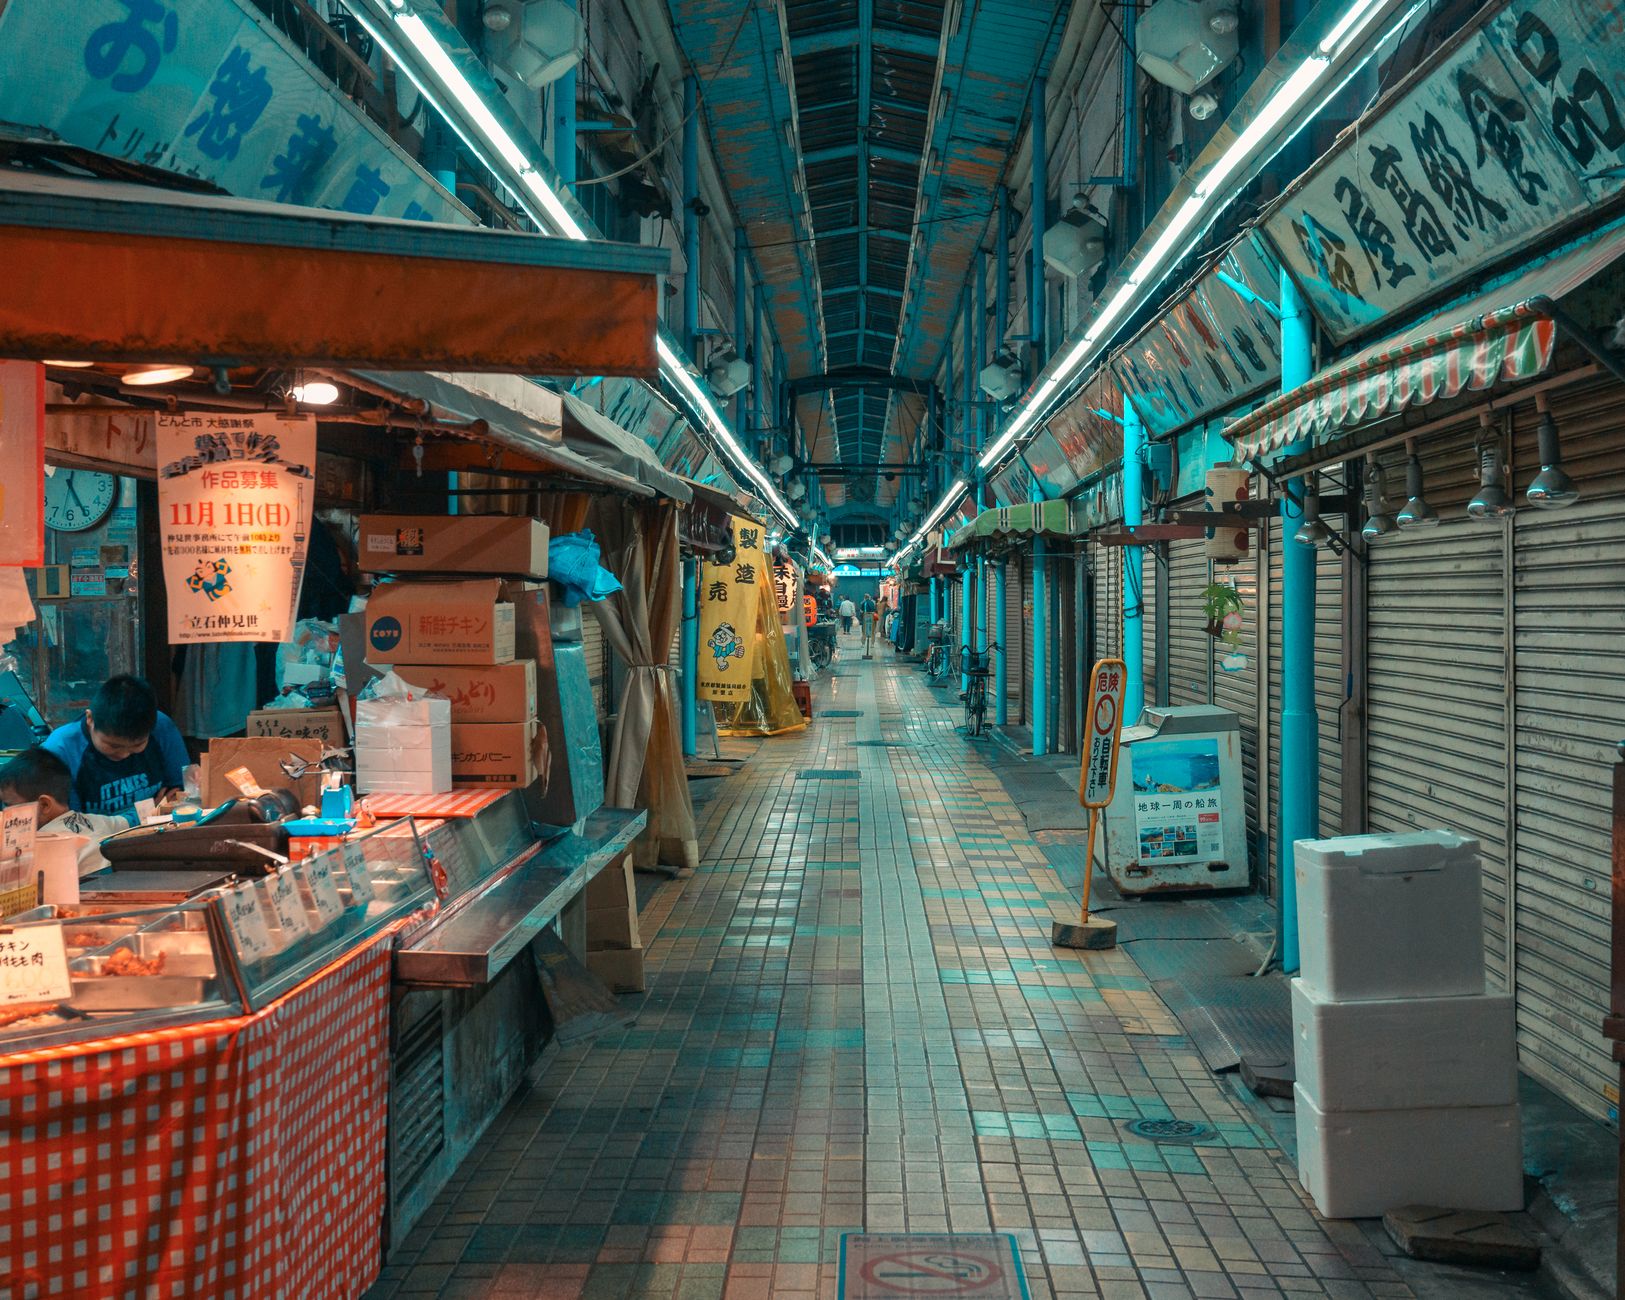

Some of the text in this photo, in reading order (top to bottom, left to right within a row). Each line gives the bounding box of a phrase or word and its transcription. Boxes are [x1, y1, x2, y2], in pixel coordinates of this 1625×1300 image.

[158, 416, 255, 429] どんと市 大感謝祭
[97, 480, 107, 493] 3
[201, 470, 279, 490] 作品募集
[92, 495, 102, 508] 4
[52, 506, 60, 518] 7
[66, 509, 75, 522] 6
[170, 500, 291, 528] 11月 1日(日)
[735, 527, 758, 585] 製造
[190, 615, 260, 629] 立石仲見世
[419, 615, 488, 637] 新鮮チキン
[372, 629, 399, 639] KOYU
[1096, 673, 1119, 693] 危険
[1087, 737, 1101, 798] おりて下さい
[1097, 737, 1112, 790] 自転車
[99, 773, 149, 801] IT TAKES
[1137, 798, 1218, 812] 地球一周の船旅
